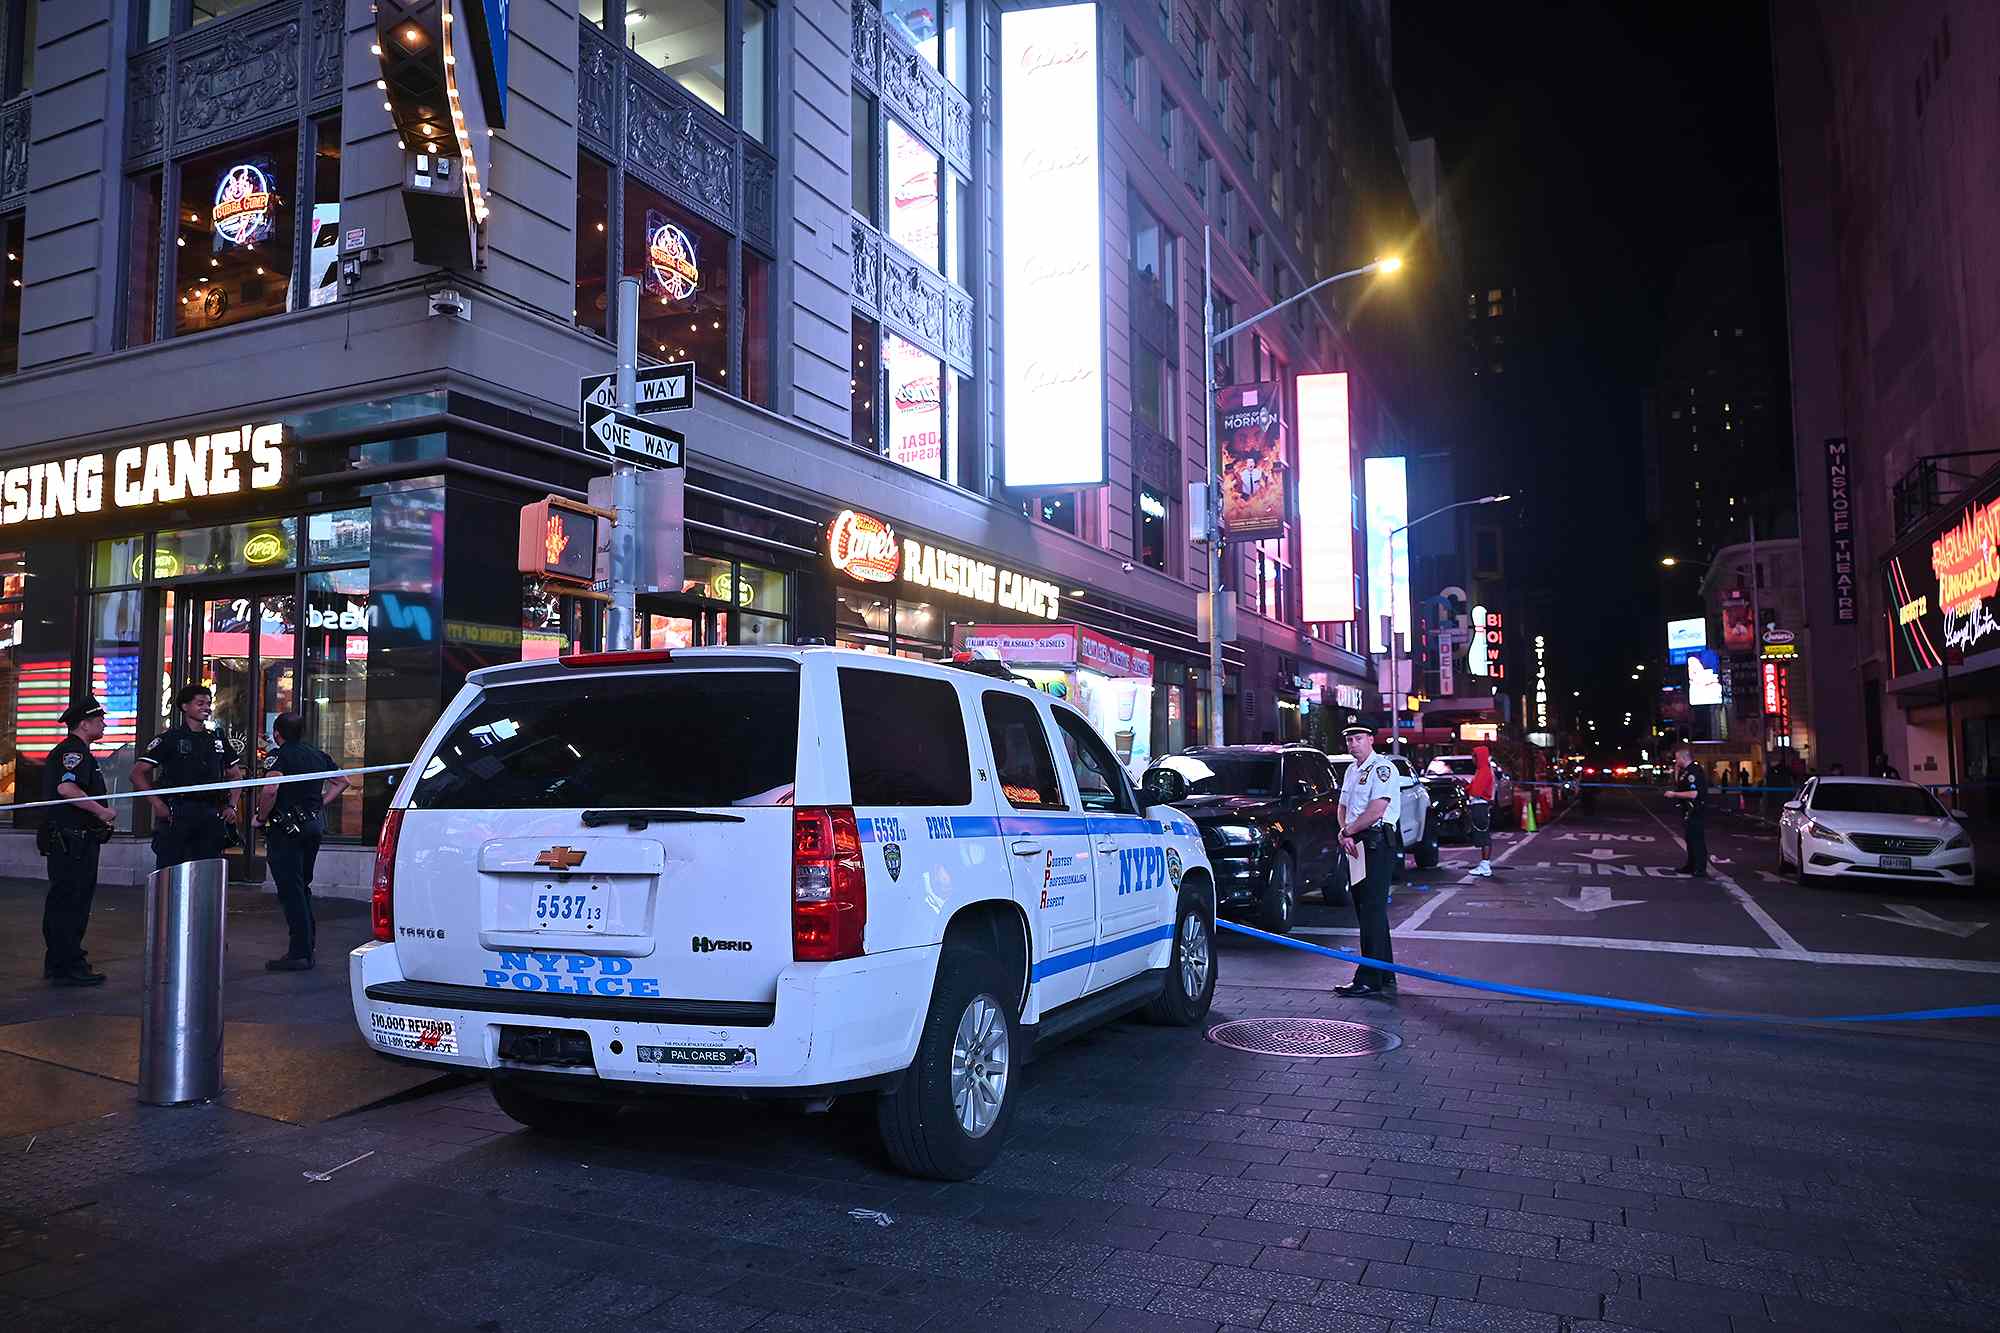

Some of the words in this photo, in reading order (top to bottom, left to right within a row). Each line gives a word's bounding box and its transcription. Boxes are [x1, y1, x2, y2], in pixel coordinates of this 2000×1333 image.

[597, 387, 617, 406] ON
[643, 379, 677, 401] WAY
[602, 422, 631, 448] ONE
[644, 434, 674, 459] WAY
[114, 423, 283, 508] CANE'S
[1829, 443, 1849, 533] MINSKOFF
[249, 540, 277, 556] OPEN
[903, 538, 997, 604] RAISING
[997, 569, 1060, 621] CANE'S
[1835, 539, 1854, 620] THEATRE
[1441, 643, 1451, 695] DELI
[1536, 667, 1547, 728] JAMES
[874, 817, 900, 842] 5537
[1552, 833, 1656, 843] ONLY
[1046, 850, 1073, 868] COURTESY
[1119, 846, 1165, 896] NYPD
[1043, 869, 1088, 888] PROFESSIONALISM
[536, 895, 586, 920] 5537
[587, 907, 601, 920] 13
[1039, 890, 1065, 910] RESPECT
[499, 951, 633, 976] NYPD
[483, 970, 661, 997] POLICE
[372, 1012, 406, 1032] $10,000
[408, 1018, 453, 1036] REWARD
[671, 1050, 690, 1060] PAL
[691, 1050, 727, 1061] CARES
